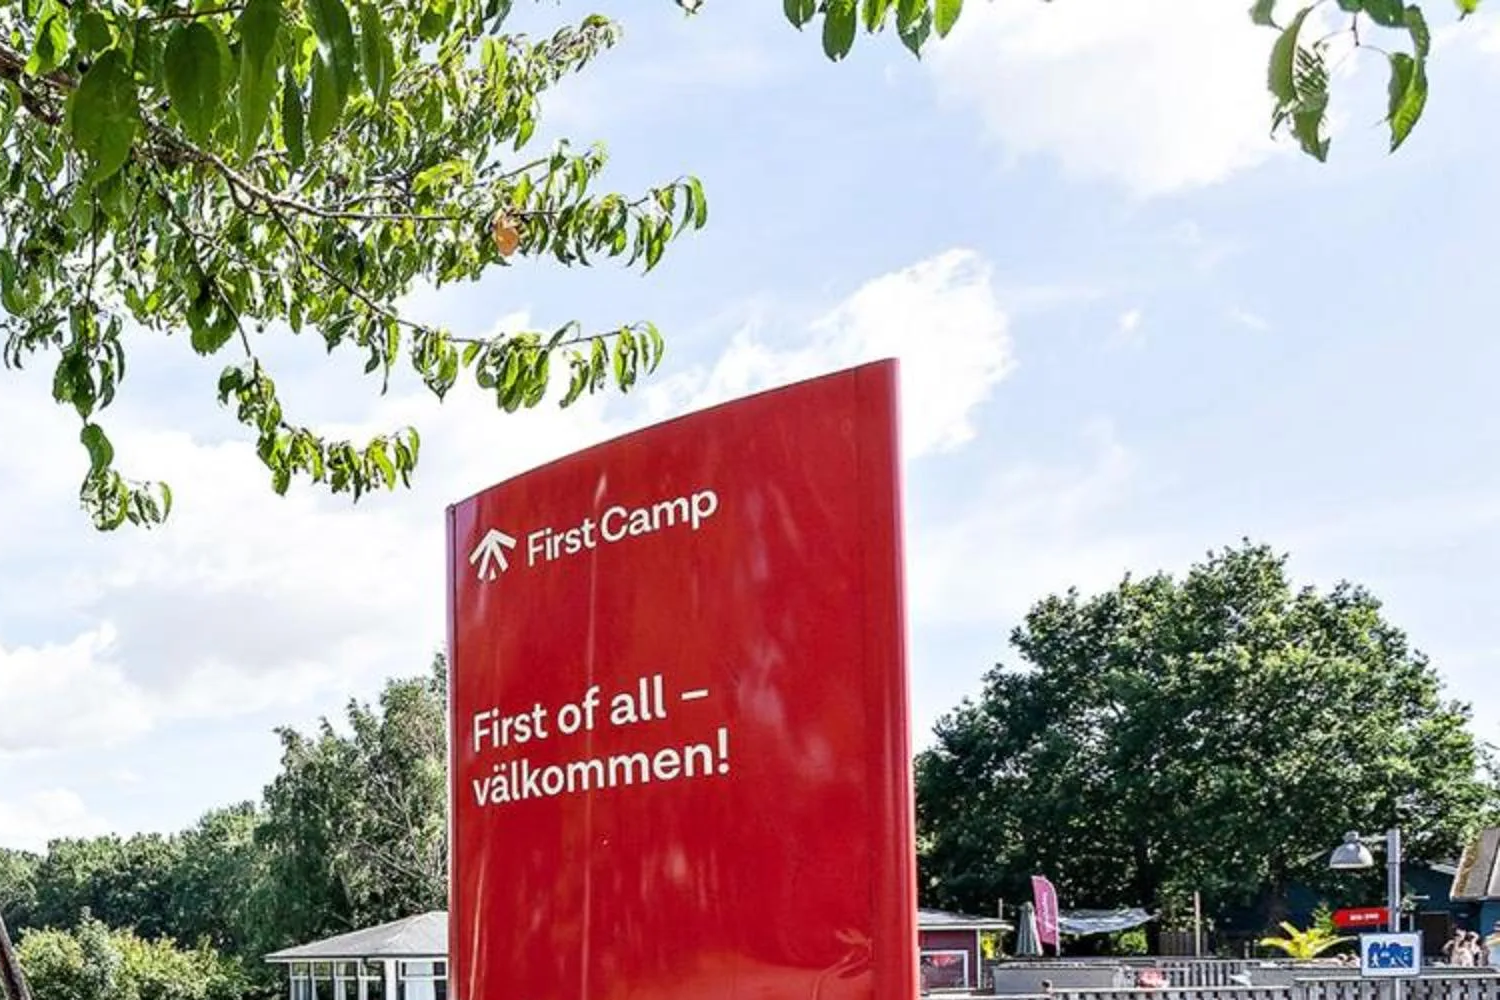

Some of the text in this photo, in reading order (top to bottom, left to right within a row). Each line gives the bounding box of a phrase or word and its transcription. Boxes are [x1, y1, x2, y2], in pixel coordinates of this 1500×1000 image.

[527, 489, 718, 567] First Camp
[473, 702, 548, 753] First
[557, 685, 600, 735] of
[610, 674, 667, 726] all
[472, 727, 730, 807] välkommen!
